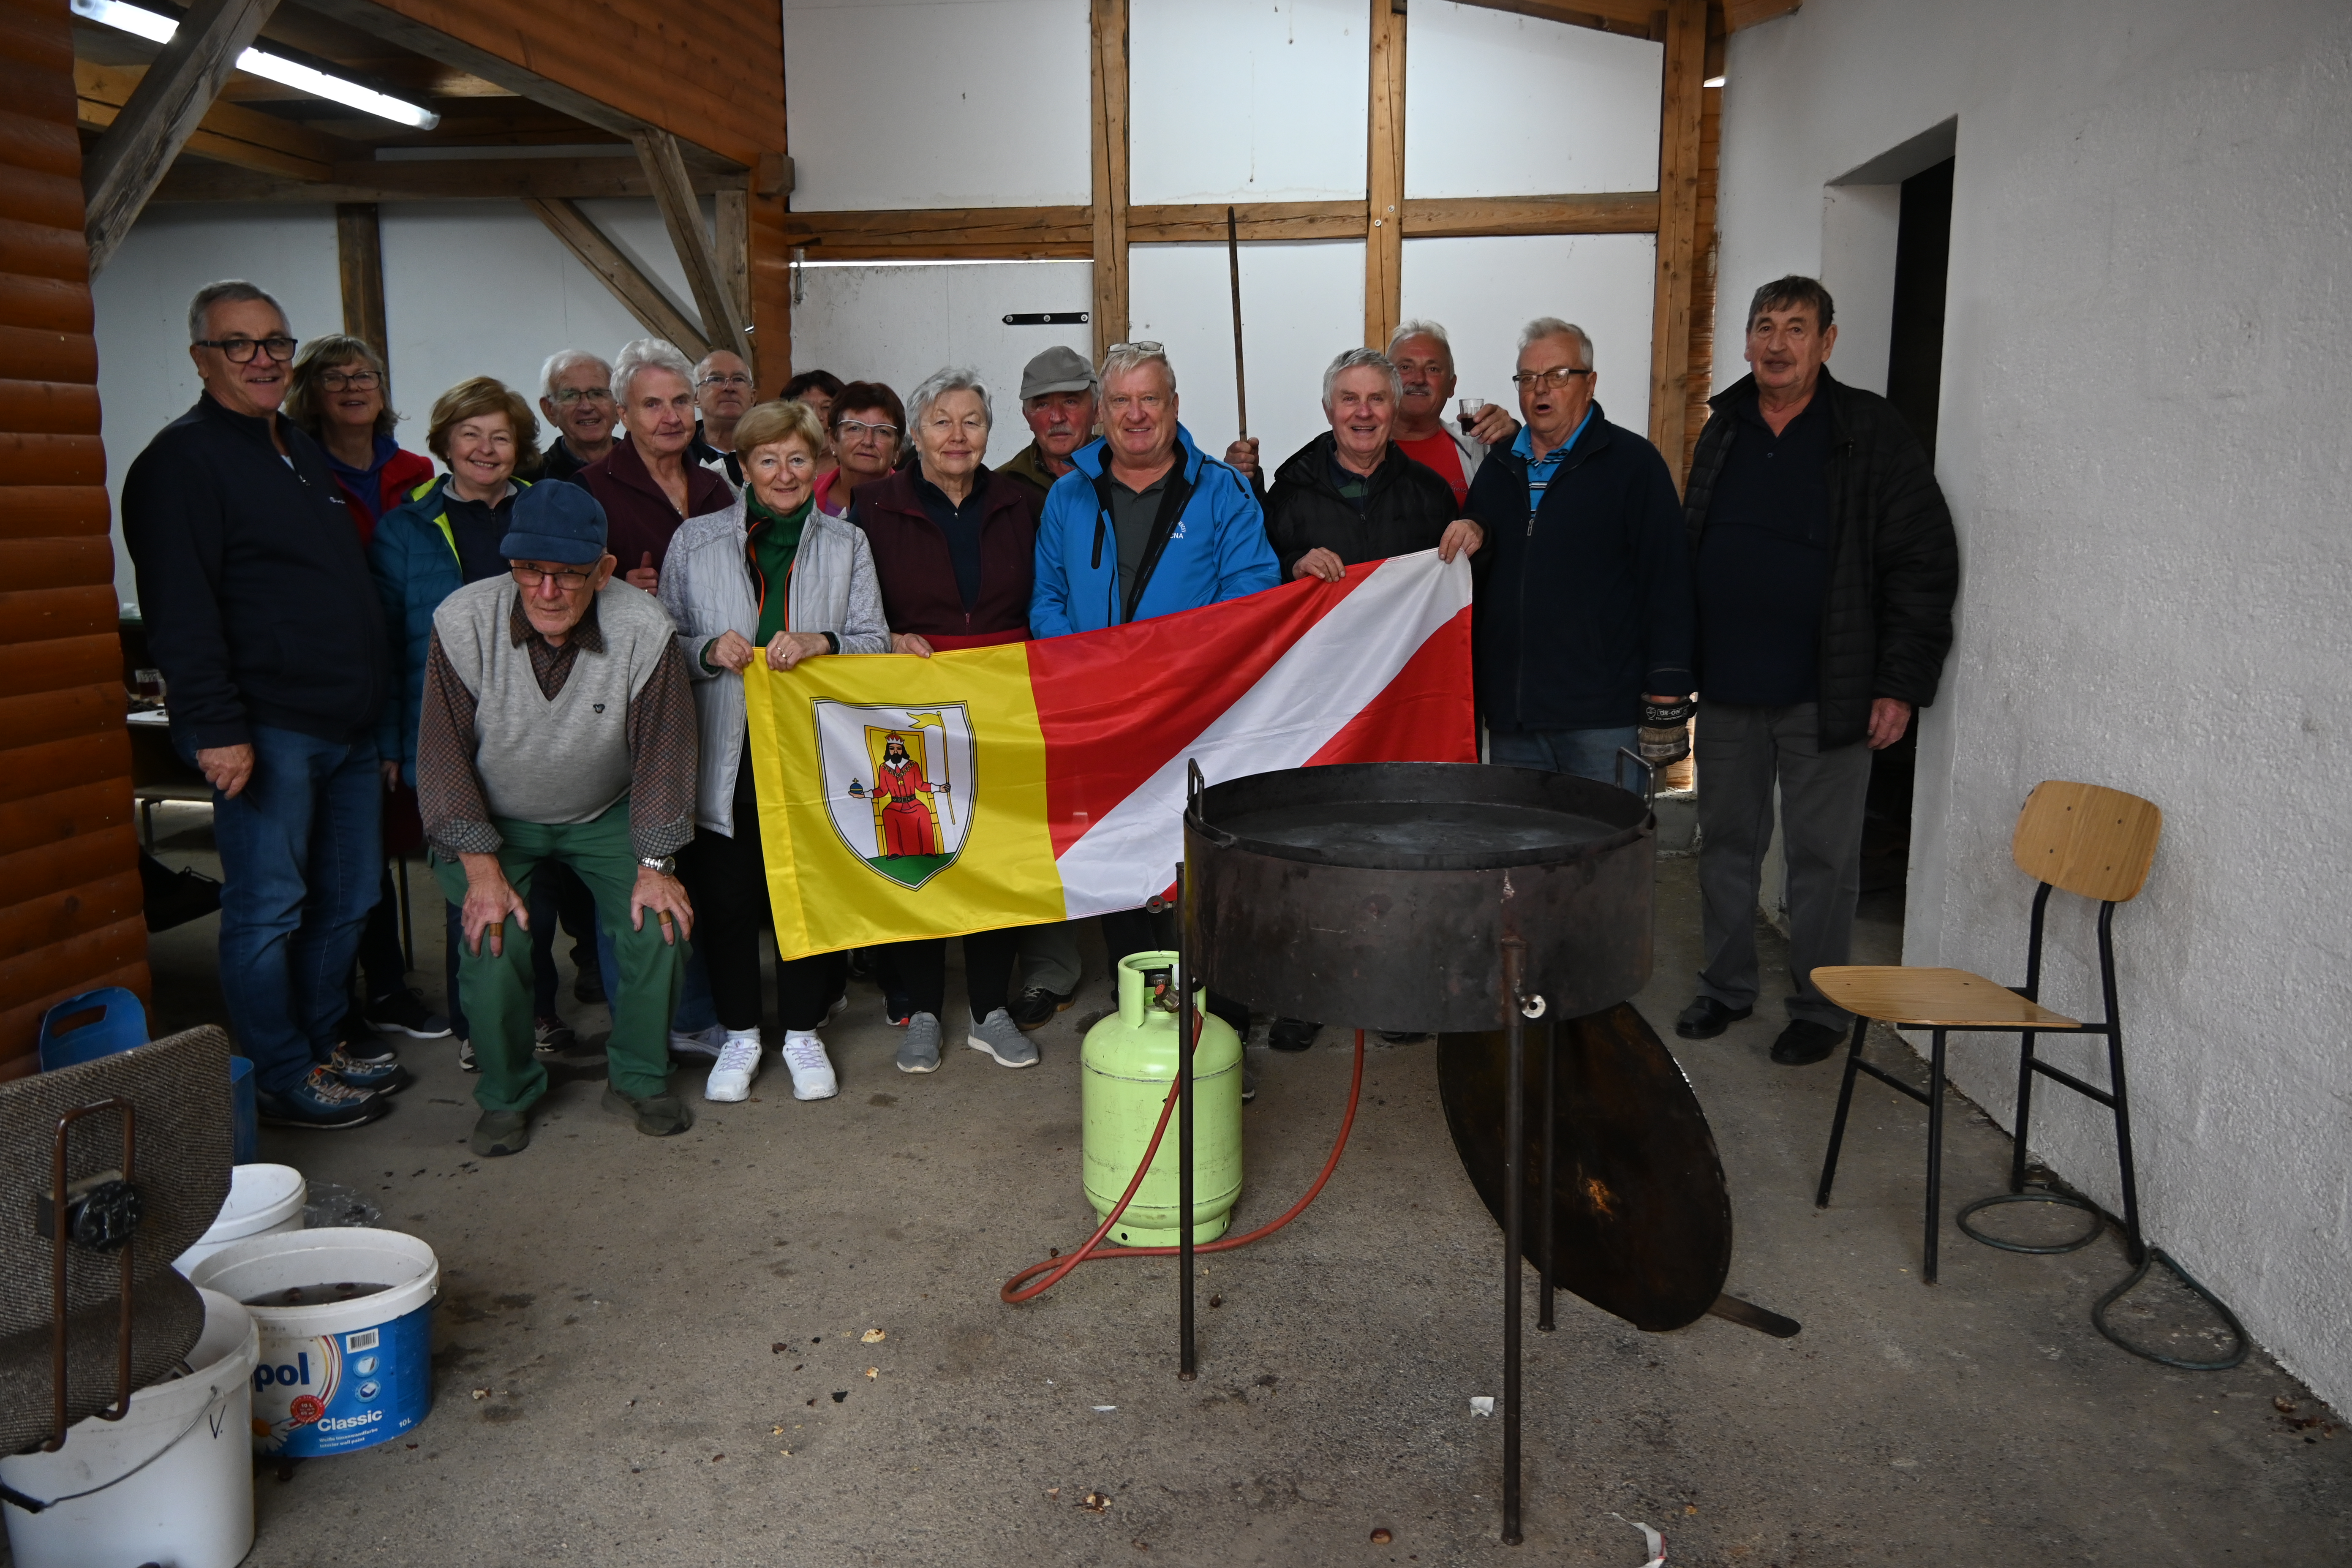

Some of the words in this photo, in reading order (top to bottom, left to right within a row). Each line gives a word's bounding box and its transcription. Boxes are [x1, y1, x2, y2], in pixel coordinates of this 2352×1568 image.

[252, 1352, 310, 1392] pol
[317, 1410, 383, 1432] Classic
[398, 1417, 412, 1428] 10L
